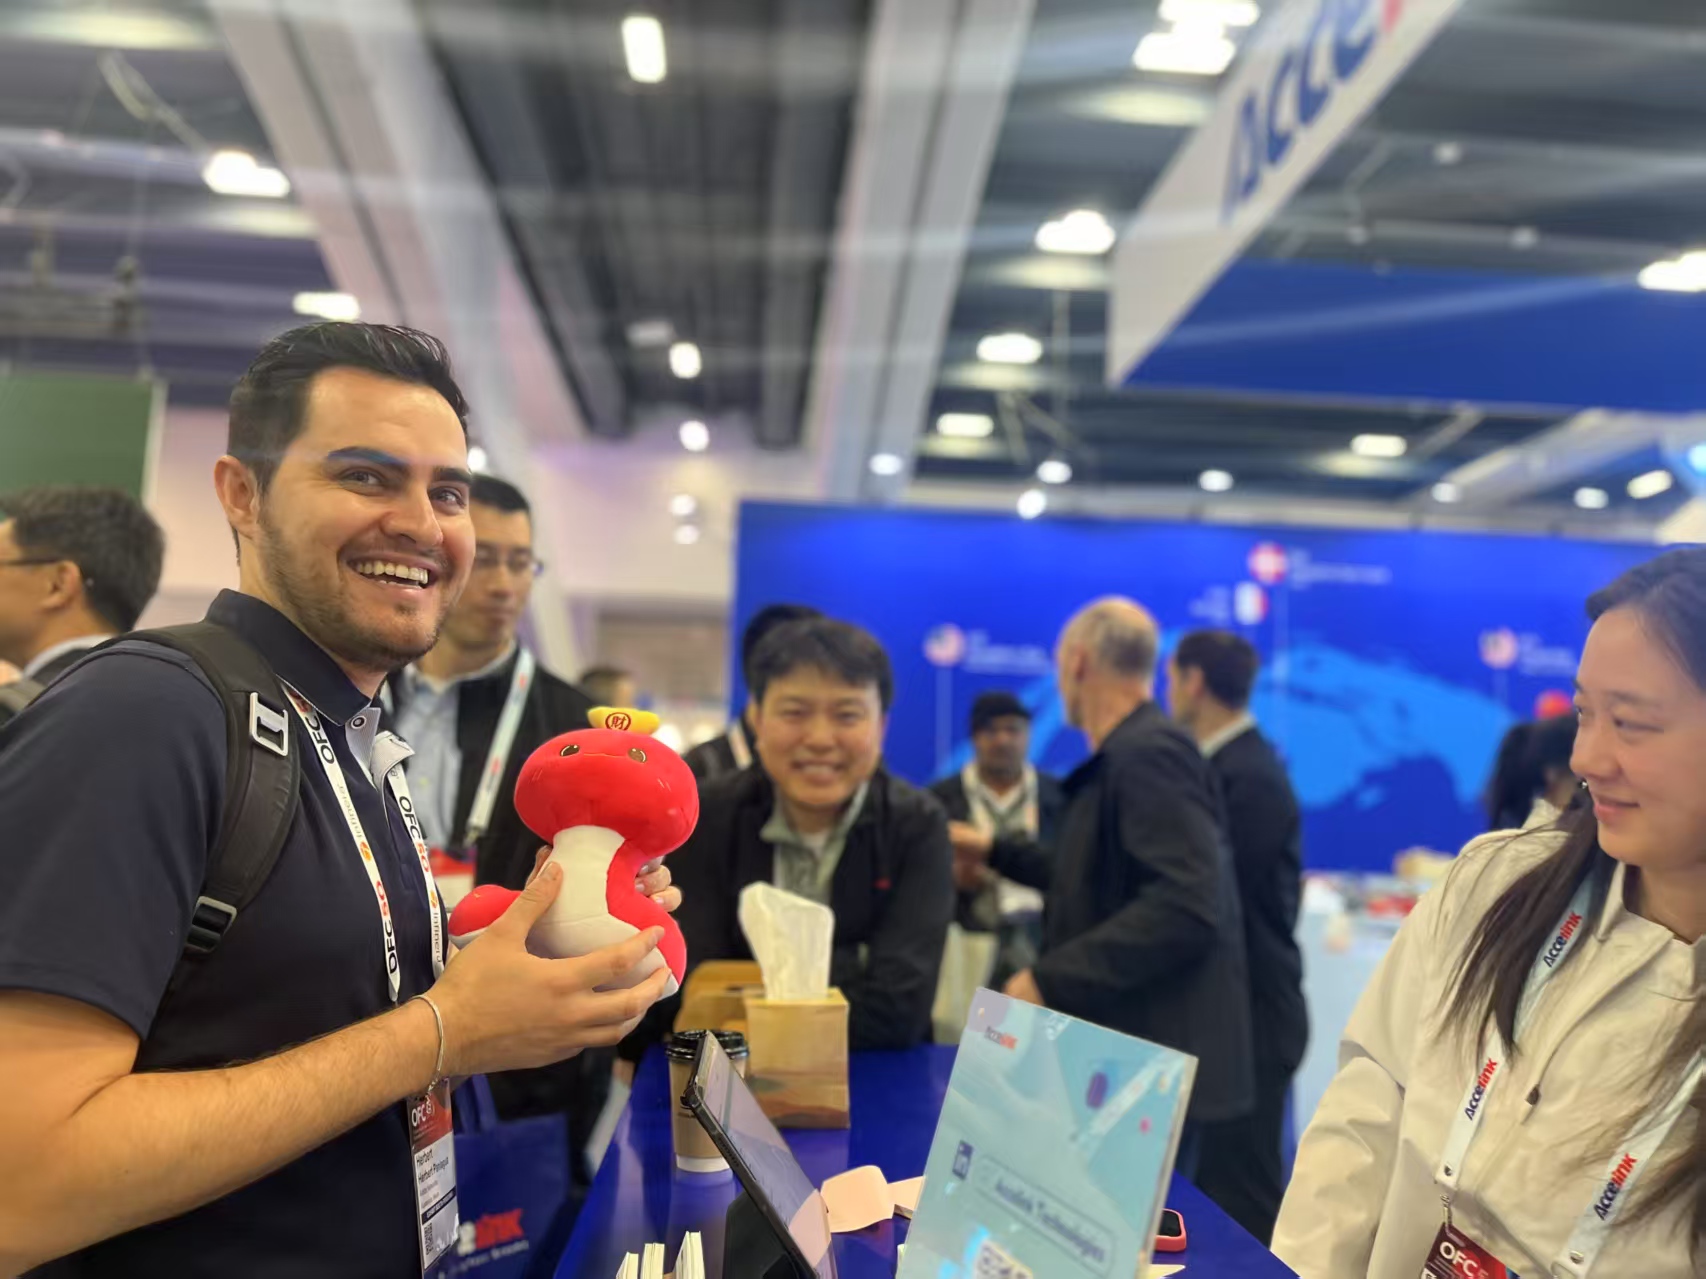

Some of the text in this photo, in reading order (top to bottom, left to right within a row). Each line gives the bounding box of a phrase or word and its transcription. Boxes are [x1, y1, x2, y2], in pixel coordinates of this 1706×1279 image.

[1542, 911, 1582, 968] Accelink
[1464, 1057, 1498, 1121] Accelink
[1593, 1153, 1638, 1220] Accelink
